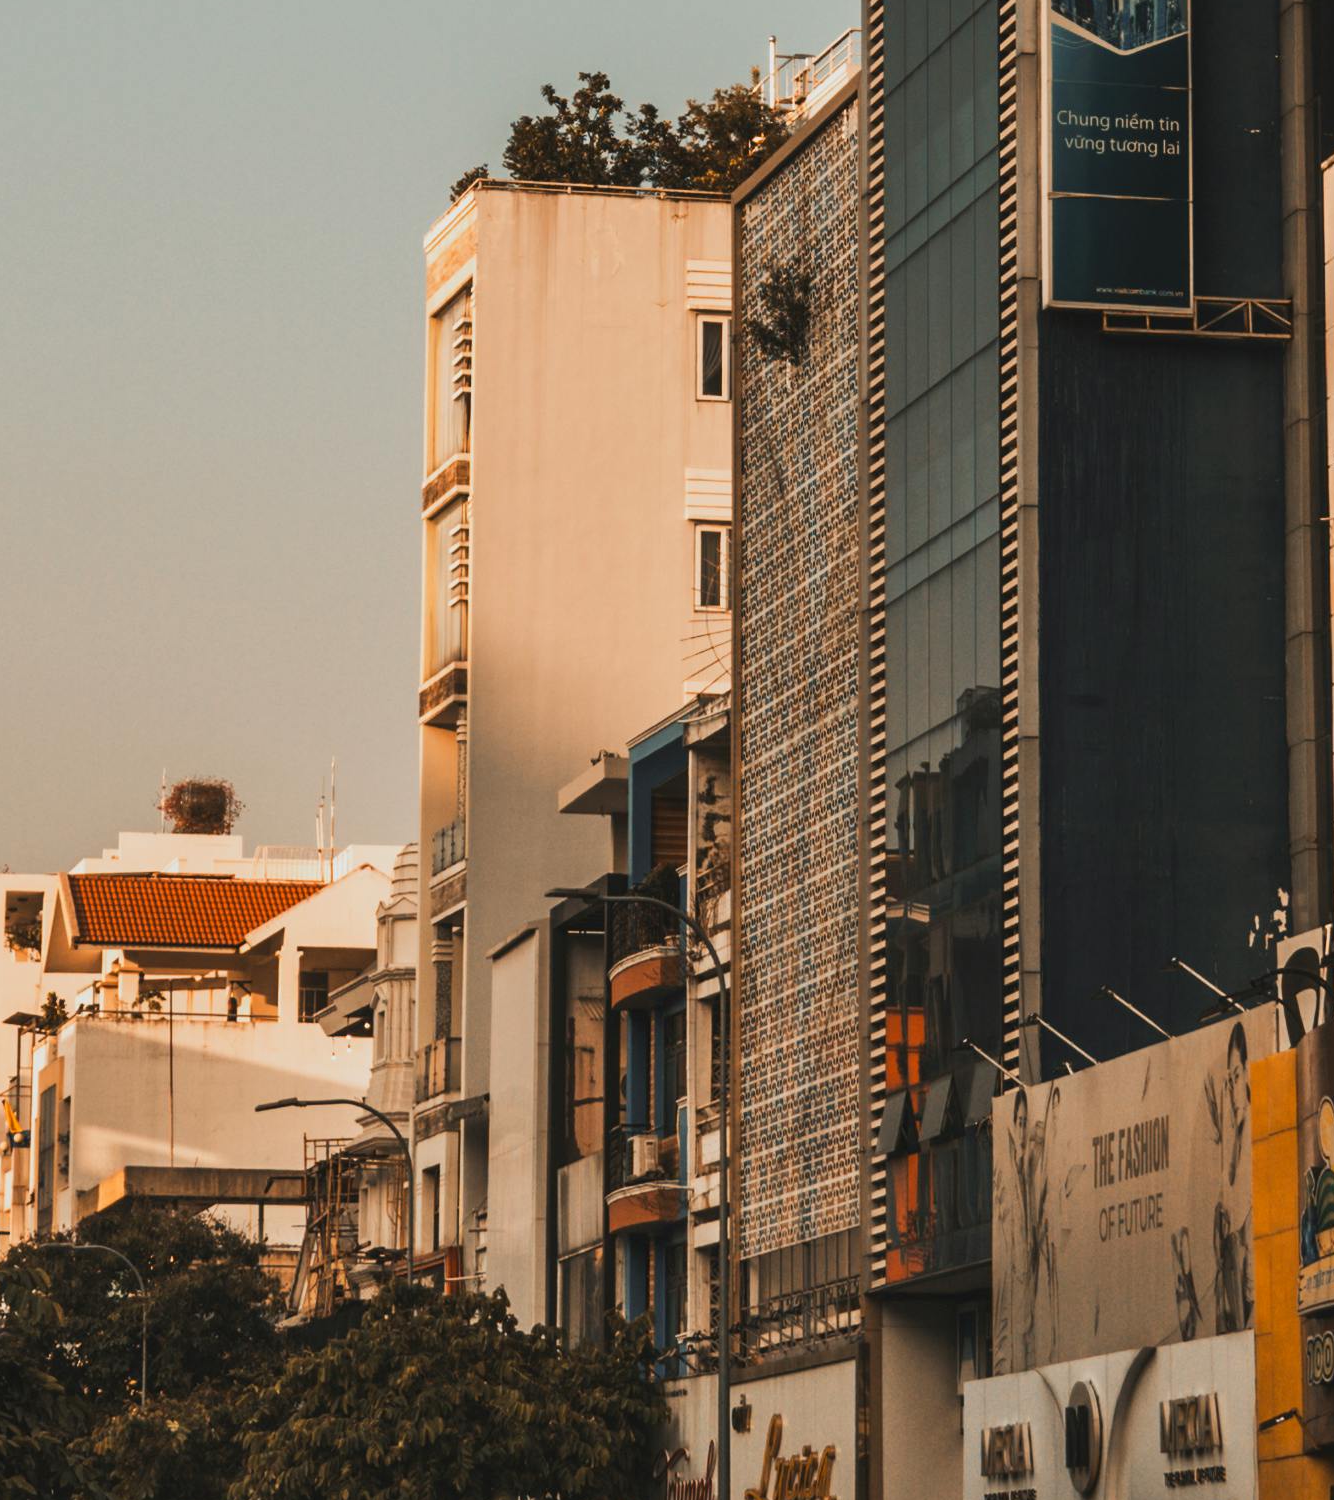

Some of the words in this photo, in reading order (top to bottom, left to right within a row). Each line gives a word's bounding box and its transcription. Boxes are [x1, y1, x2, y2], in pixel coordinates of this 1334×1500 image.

[1057, 110, 1110, 131] Chung
[1115, 112, 1154, 131] niềm
[1159, 116, 1180, 132] tin
[1064, 134, 1105, 155] vững
[1110, 138, 1157, 157] tương
[1163, 140, 1180, 155] lai
[1092, 1131, 1115, 1189] THE
[1118, 1114, 1169, 1182] FASHION
[1099, 1206, 1115, 1242] OF
[1118, 1192, 1163, 1238] FUTURE
